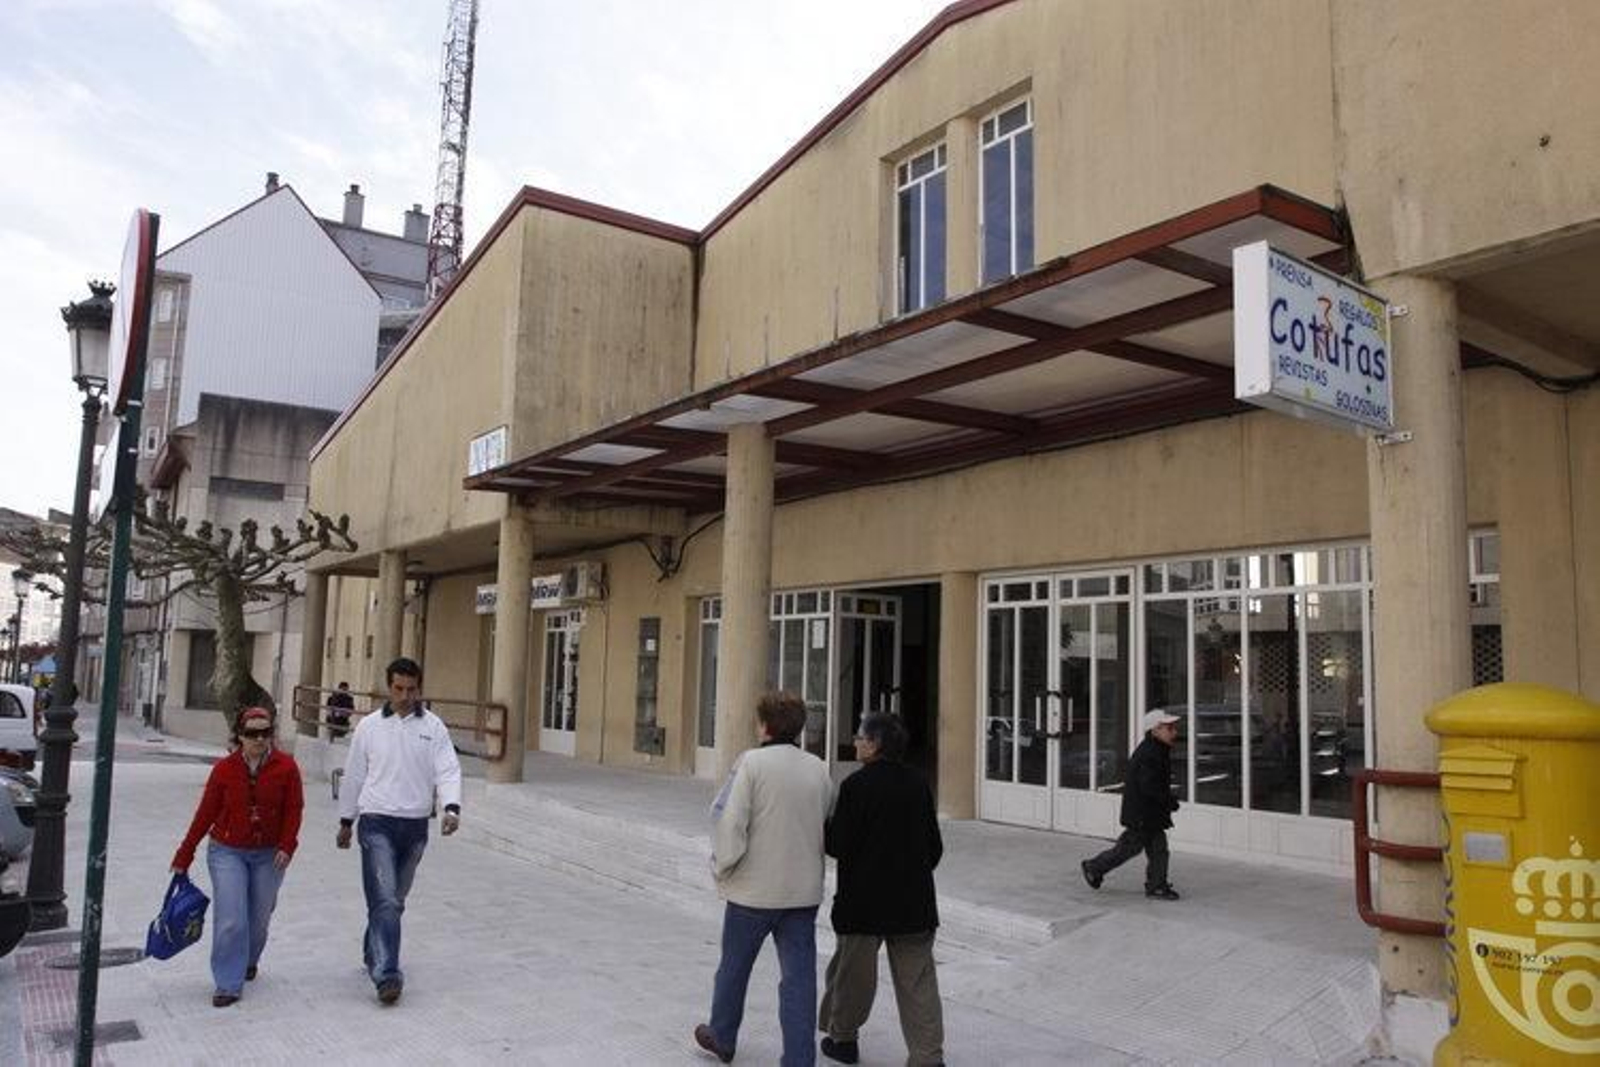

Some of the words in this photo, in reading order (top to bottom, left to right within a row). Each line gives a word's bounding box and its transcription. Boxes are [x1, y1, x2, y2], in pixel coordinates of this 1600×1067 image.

[1276, 258, 1314, 290] PRENSA
[1338, 299, 1379, 331] REGALOS
[1270, 297, 1386, 382] Cotufas
[1279, 354, 1329, 387] REVISTAS
